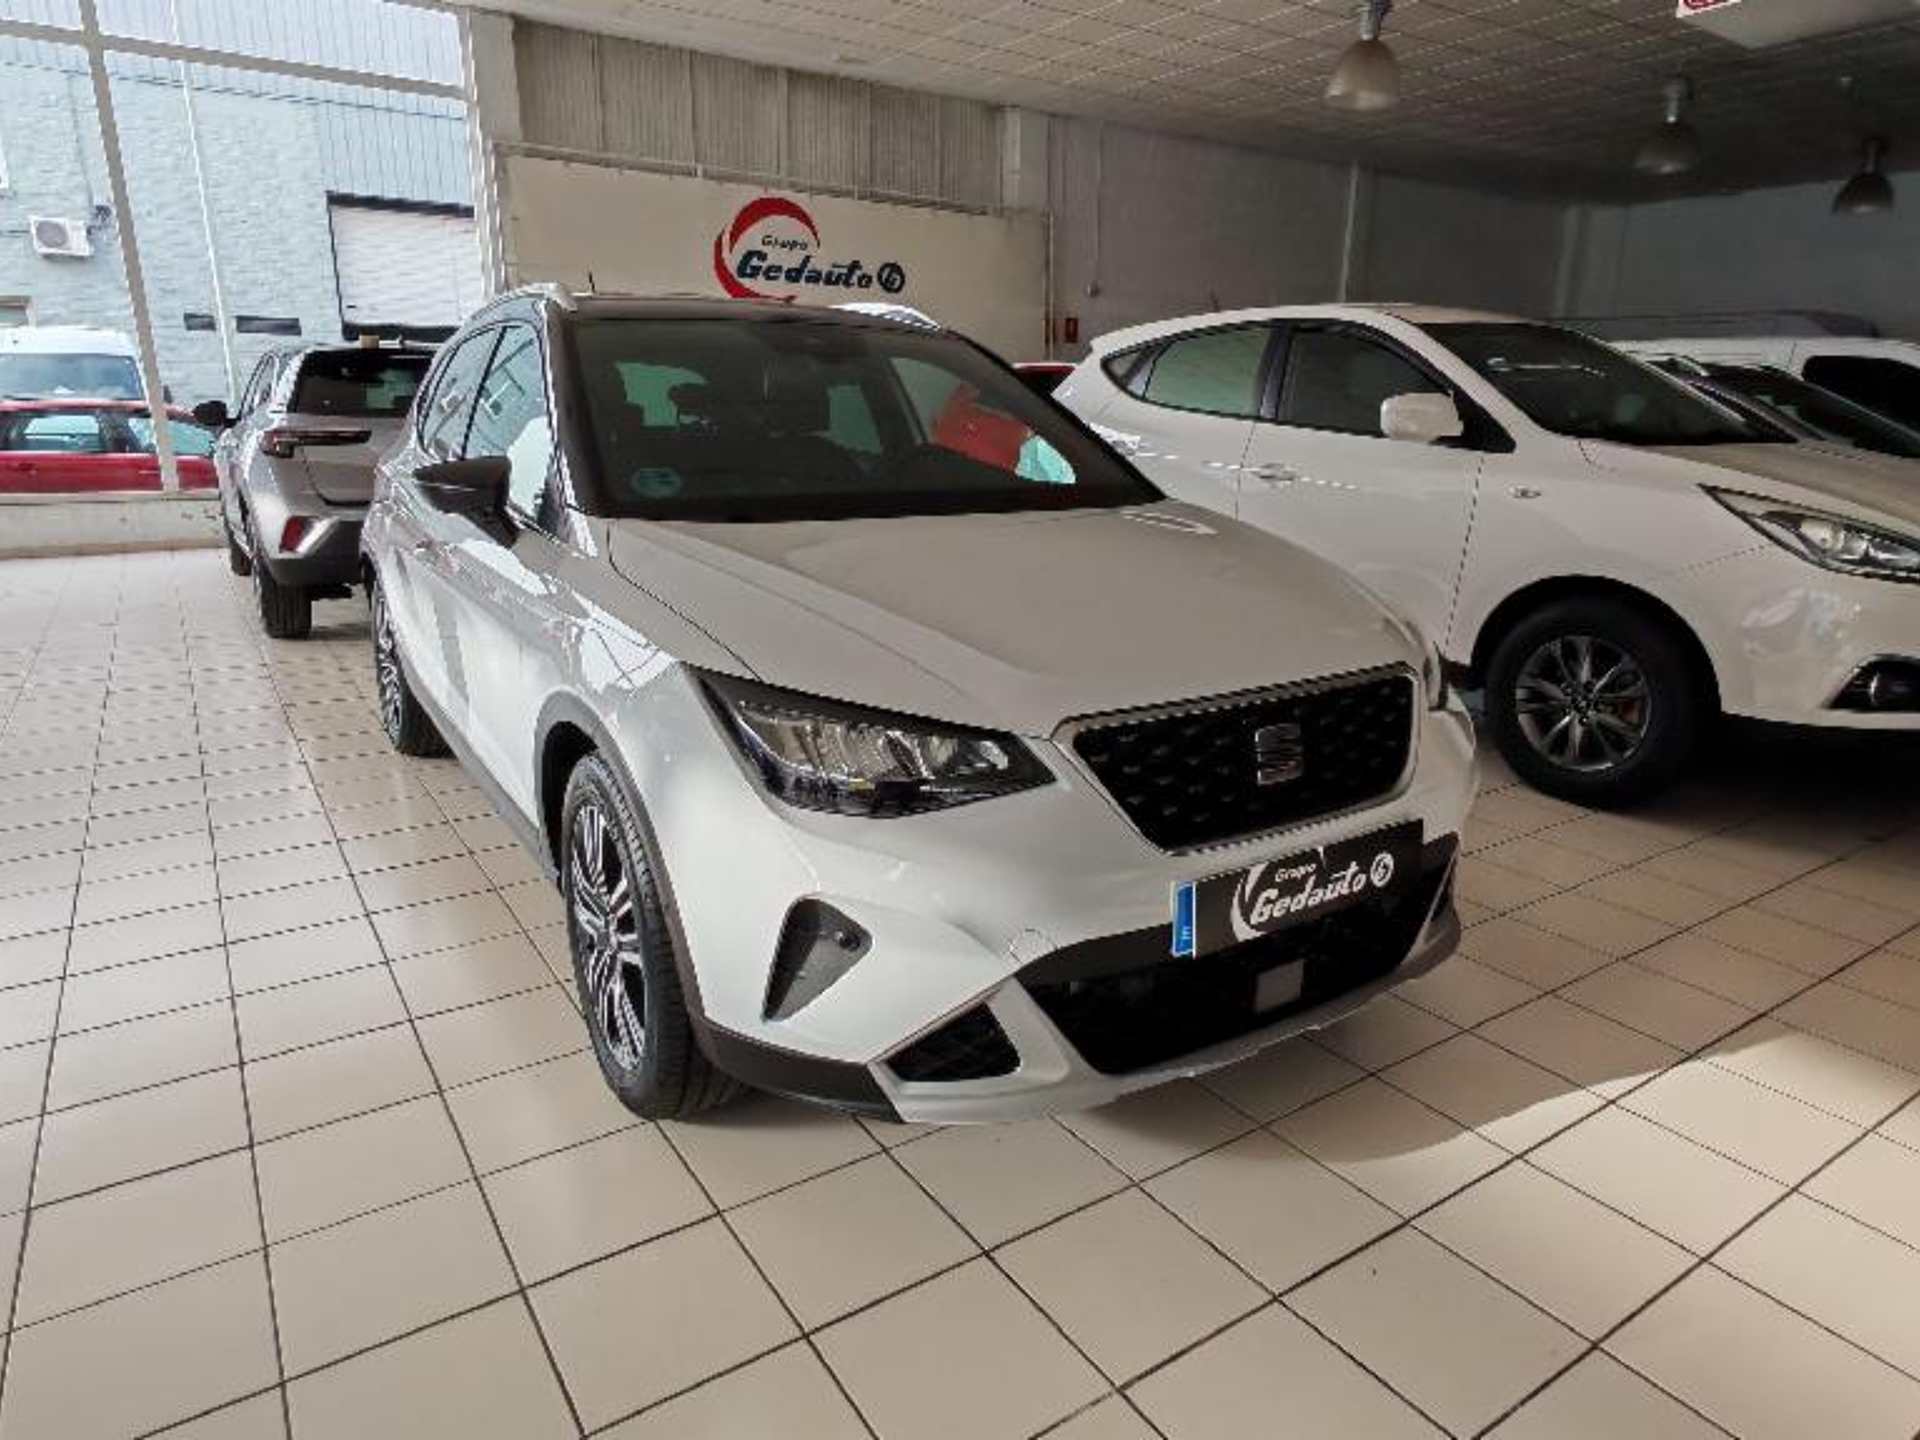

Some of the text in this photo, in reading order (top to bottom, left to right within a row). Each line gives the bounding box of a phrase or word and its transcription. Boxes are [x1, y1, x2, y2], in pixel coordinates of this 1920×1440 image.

[761, 235, 808, 251] Grupo
[736, 250, 873, 289] Gedauto
[1275, 863, 1317, 882] Grupo
[1250, 861, 1367, 925] Gedauto
